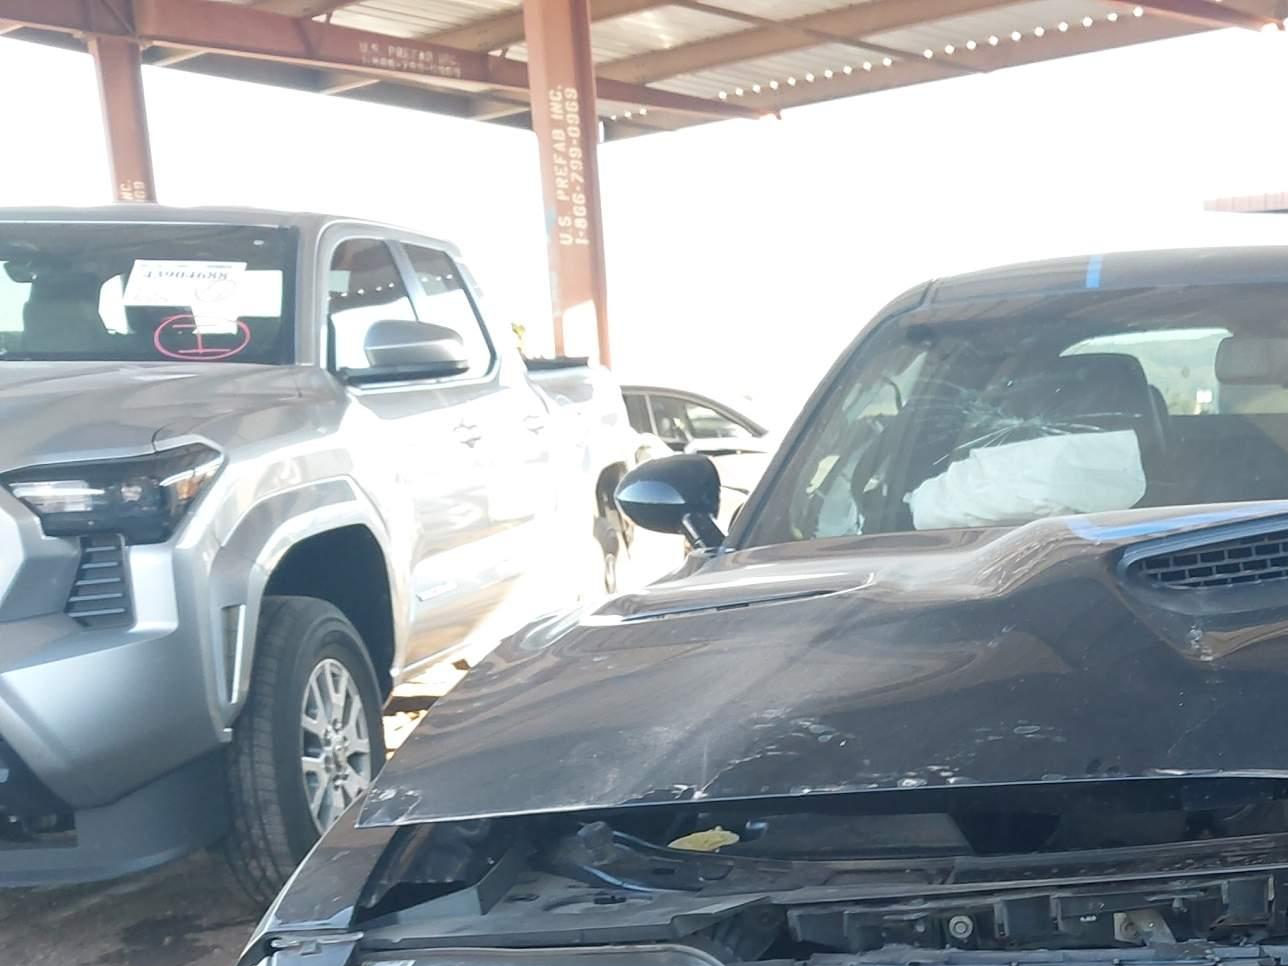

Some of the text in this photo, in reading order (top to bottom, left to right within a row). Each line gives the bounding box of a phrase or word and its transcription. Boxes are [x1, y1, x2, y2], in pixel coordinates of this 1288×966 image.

[549, 84, 565, 121] INC.
[551, 128, 571, 202] PREFAB
[564, 87, 590, 245] 1-866-799-0969
